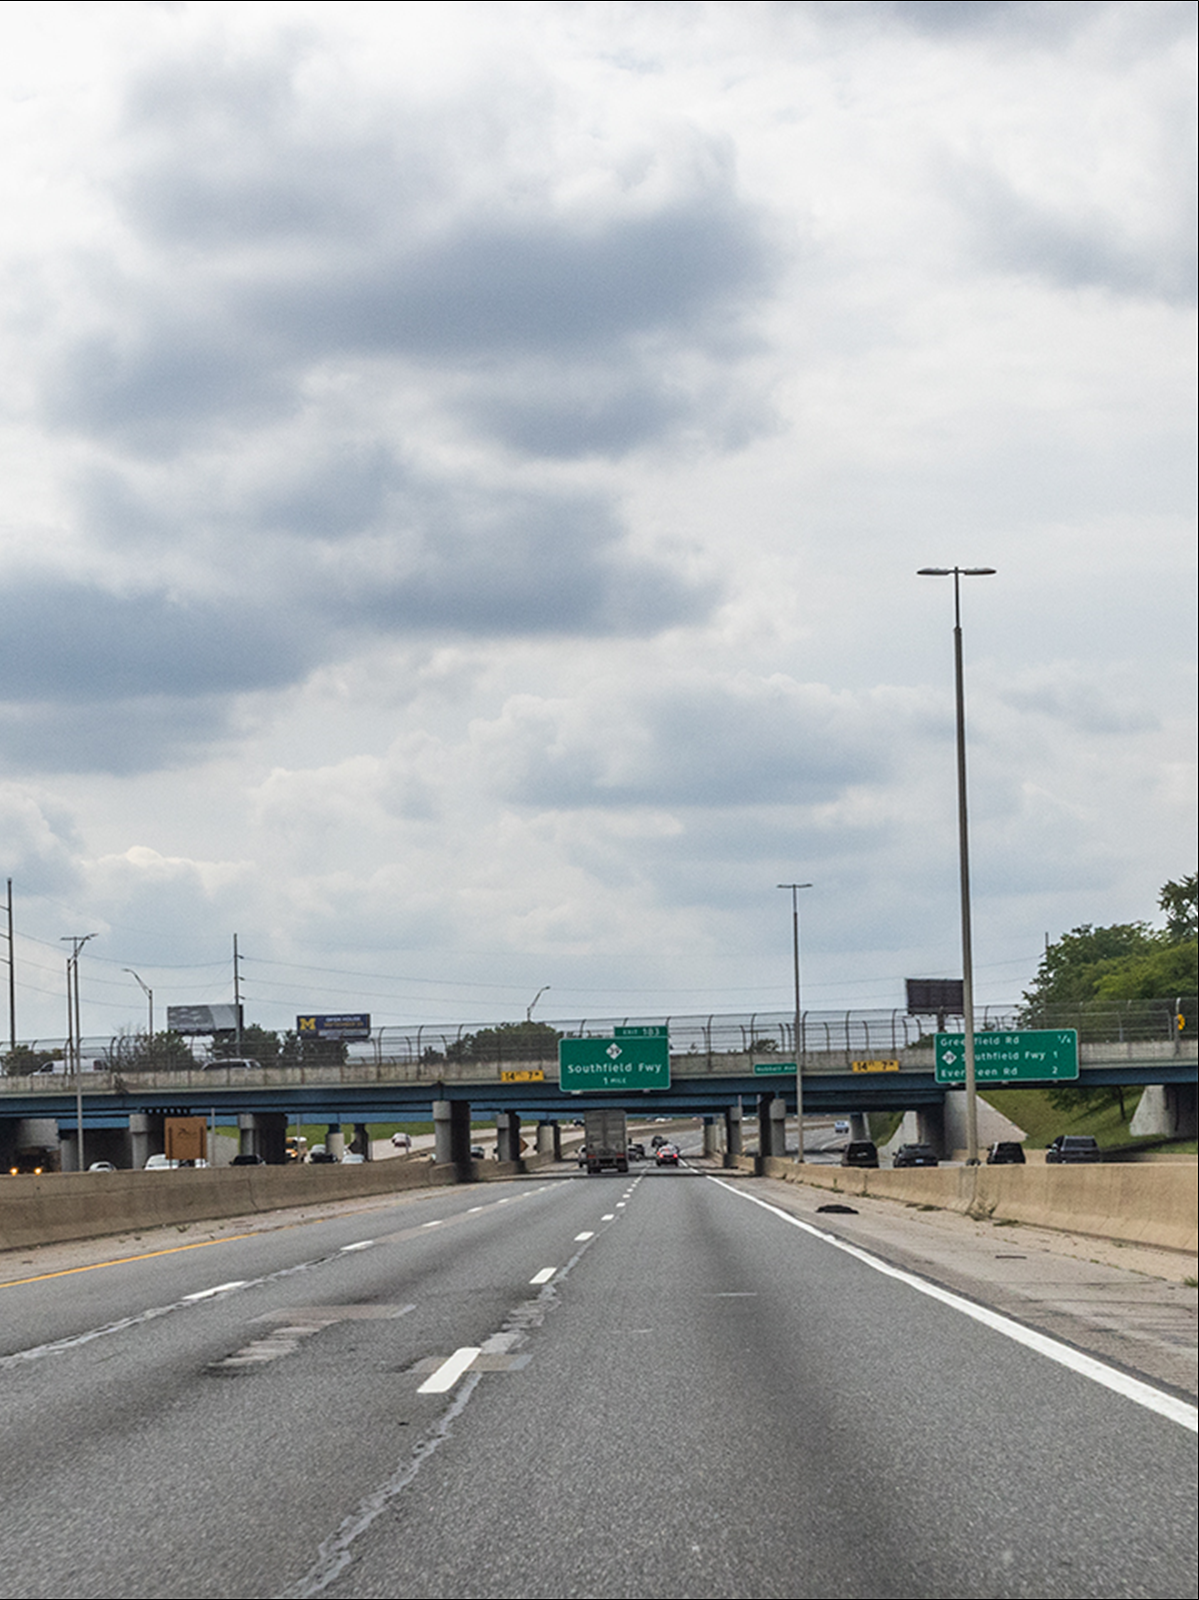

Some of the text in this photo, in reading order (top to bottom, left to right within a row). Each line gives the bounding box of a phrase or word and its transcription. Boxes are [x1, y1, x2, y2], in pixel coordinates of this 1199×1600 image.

[299, 1018, 316, 1030] M
[940, 1037, 1000, 1047] Greefield
[1005, 1036, 1020, 1045] Rd
[961, 1050, 1058, 1061] Suthfield Fwy 1
[567, 1063, 662, 1075] Southfield Fwy
[941, 1066, 1058, 1077] Evereen Rd 2
[603, 1077, 609, 1085] 1
